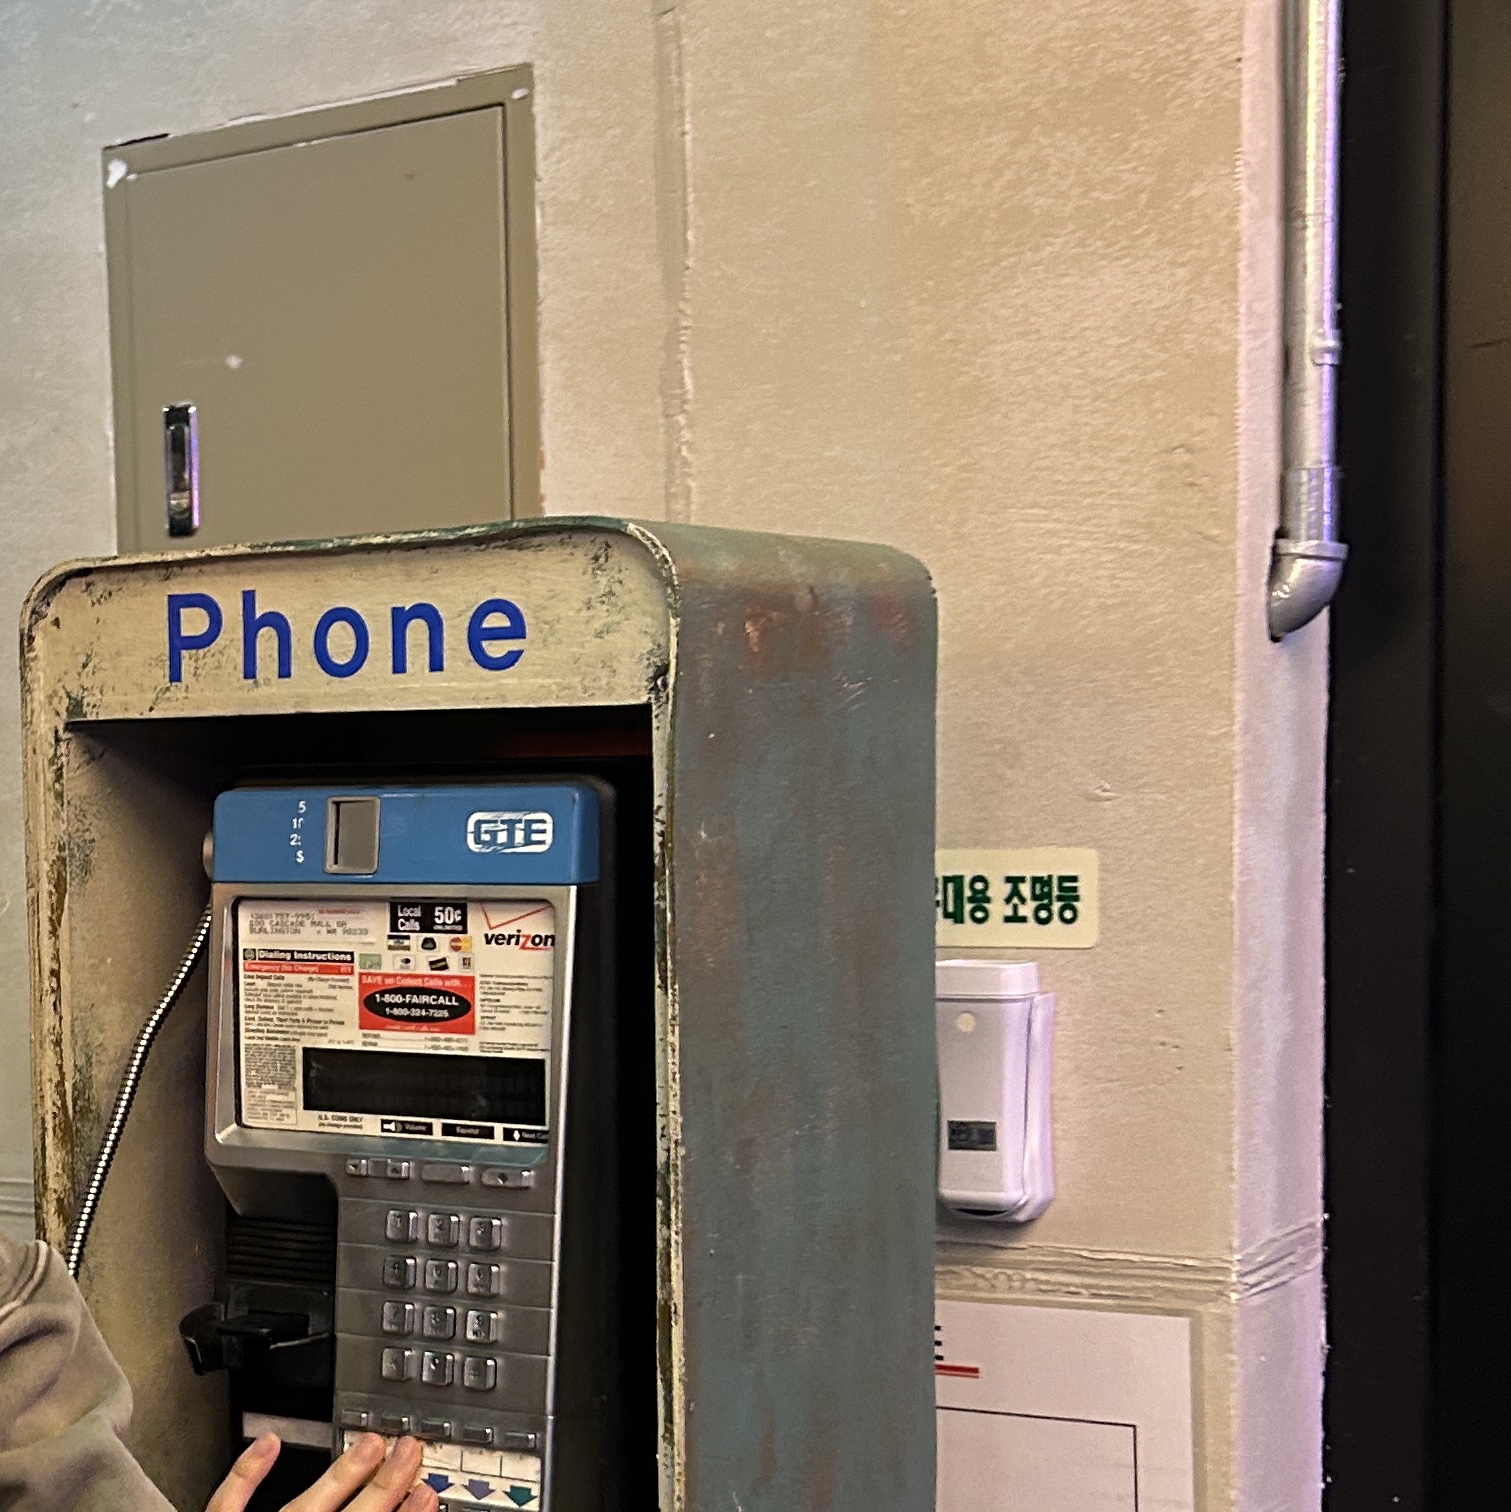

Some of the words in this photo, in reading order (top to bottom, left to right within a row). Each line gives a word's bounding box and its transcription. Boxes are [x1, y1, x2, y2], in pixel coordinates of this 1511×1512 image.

[166, 589, 528, 683] Phone
[471, 816, 549, 848] GTE
[936, 874, 992, 925] 대용
[1002, 874, 1081, 926] 조명등
[397, 904, 422, 918] Local
[433, 906, 463, 925] 50¢
[397, 918, 421, 931] Calls
[483, 929, 556, 950] verizon
[259, 950, 292, 961] Dialing
[293, 950, 352, 962] Instructions
[361, 974, 383, 985] SAVE
[375, 993, 459, 1006] 1-800-FAIRCALL
